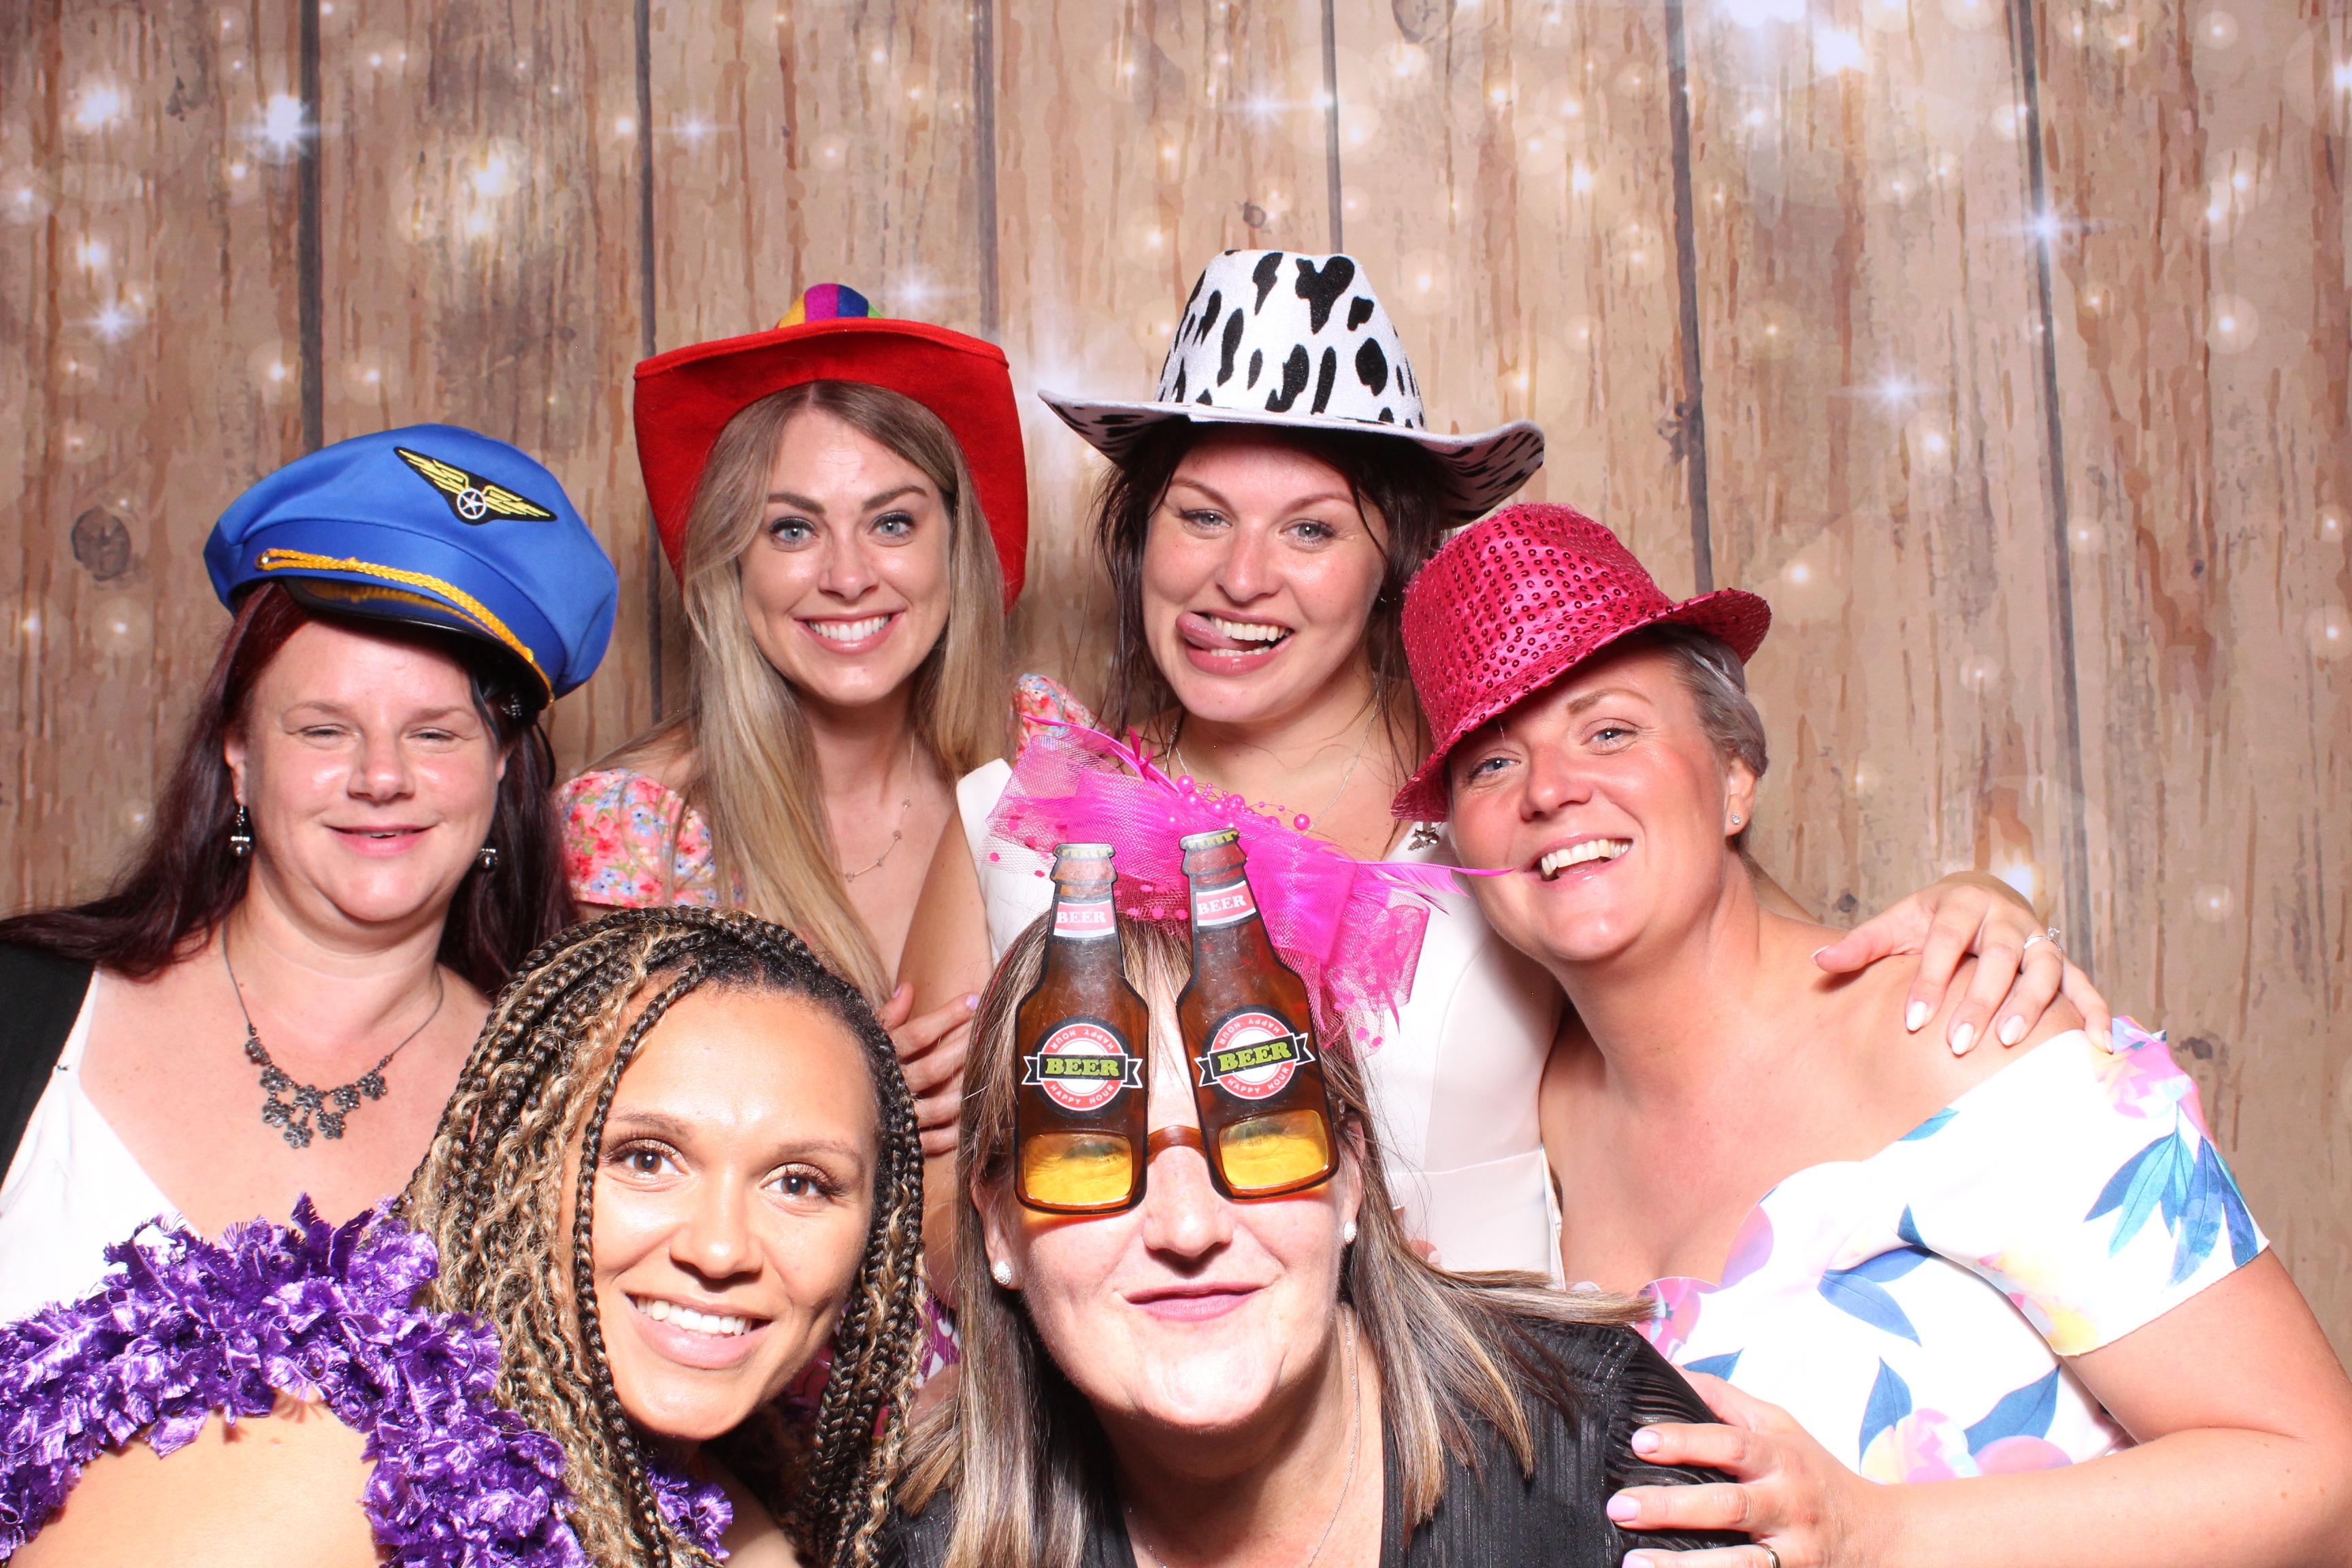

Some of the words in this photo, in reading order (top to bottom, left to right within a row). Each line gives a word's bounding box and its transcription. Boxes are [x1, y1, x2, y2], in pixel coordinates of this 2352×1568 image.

[1196, 894, 1247, 915] BEER
[1056, 910, 1107, 924] BEER
[1218, 1022, 1241, 1045] HOUR
[1248, 1018, 1280, 1034] HAPPY
[1050, 1029, 1075, 1050] HOUR
[1084, 1028, 1115, 1050] HAPPY
[1218, 1041, 1292, 1072] BEER
[1045, 1058, 1121, 1077] BEER
[1227, 1079, 1260, 1094] HAPPY
[1268, 1067, 1290, 1090] HOUR
[1050, 1084, 1081, 1105] HAPPY
[1089, 1084, 1115, 1105] HOUR
